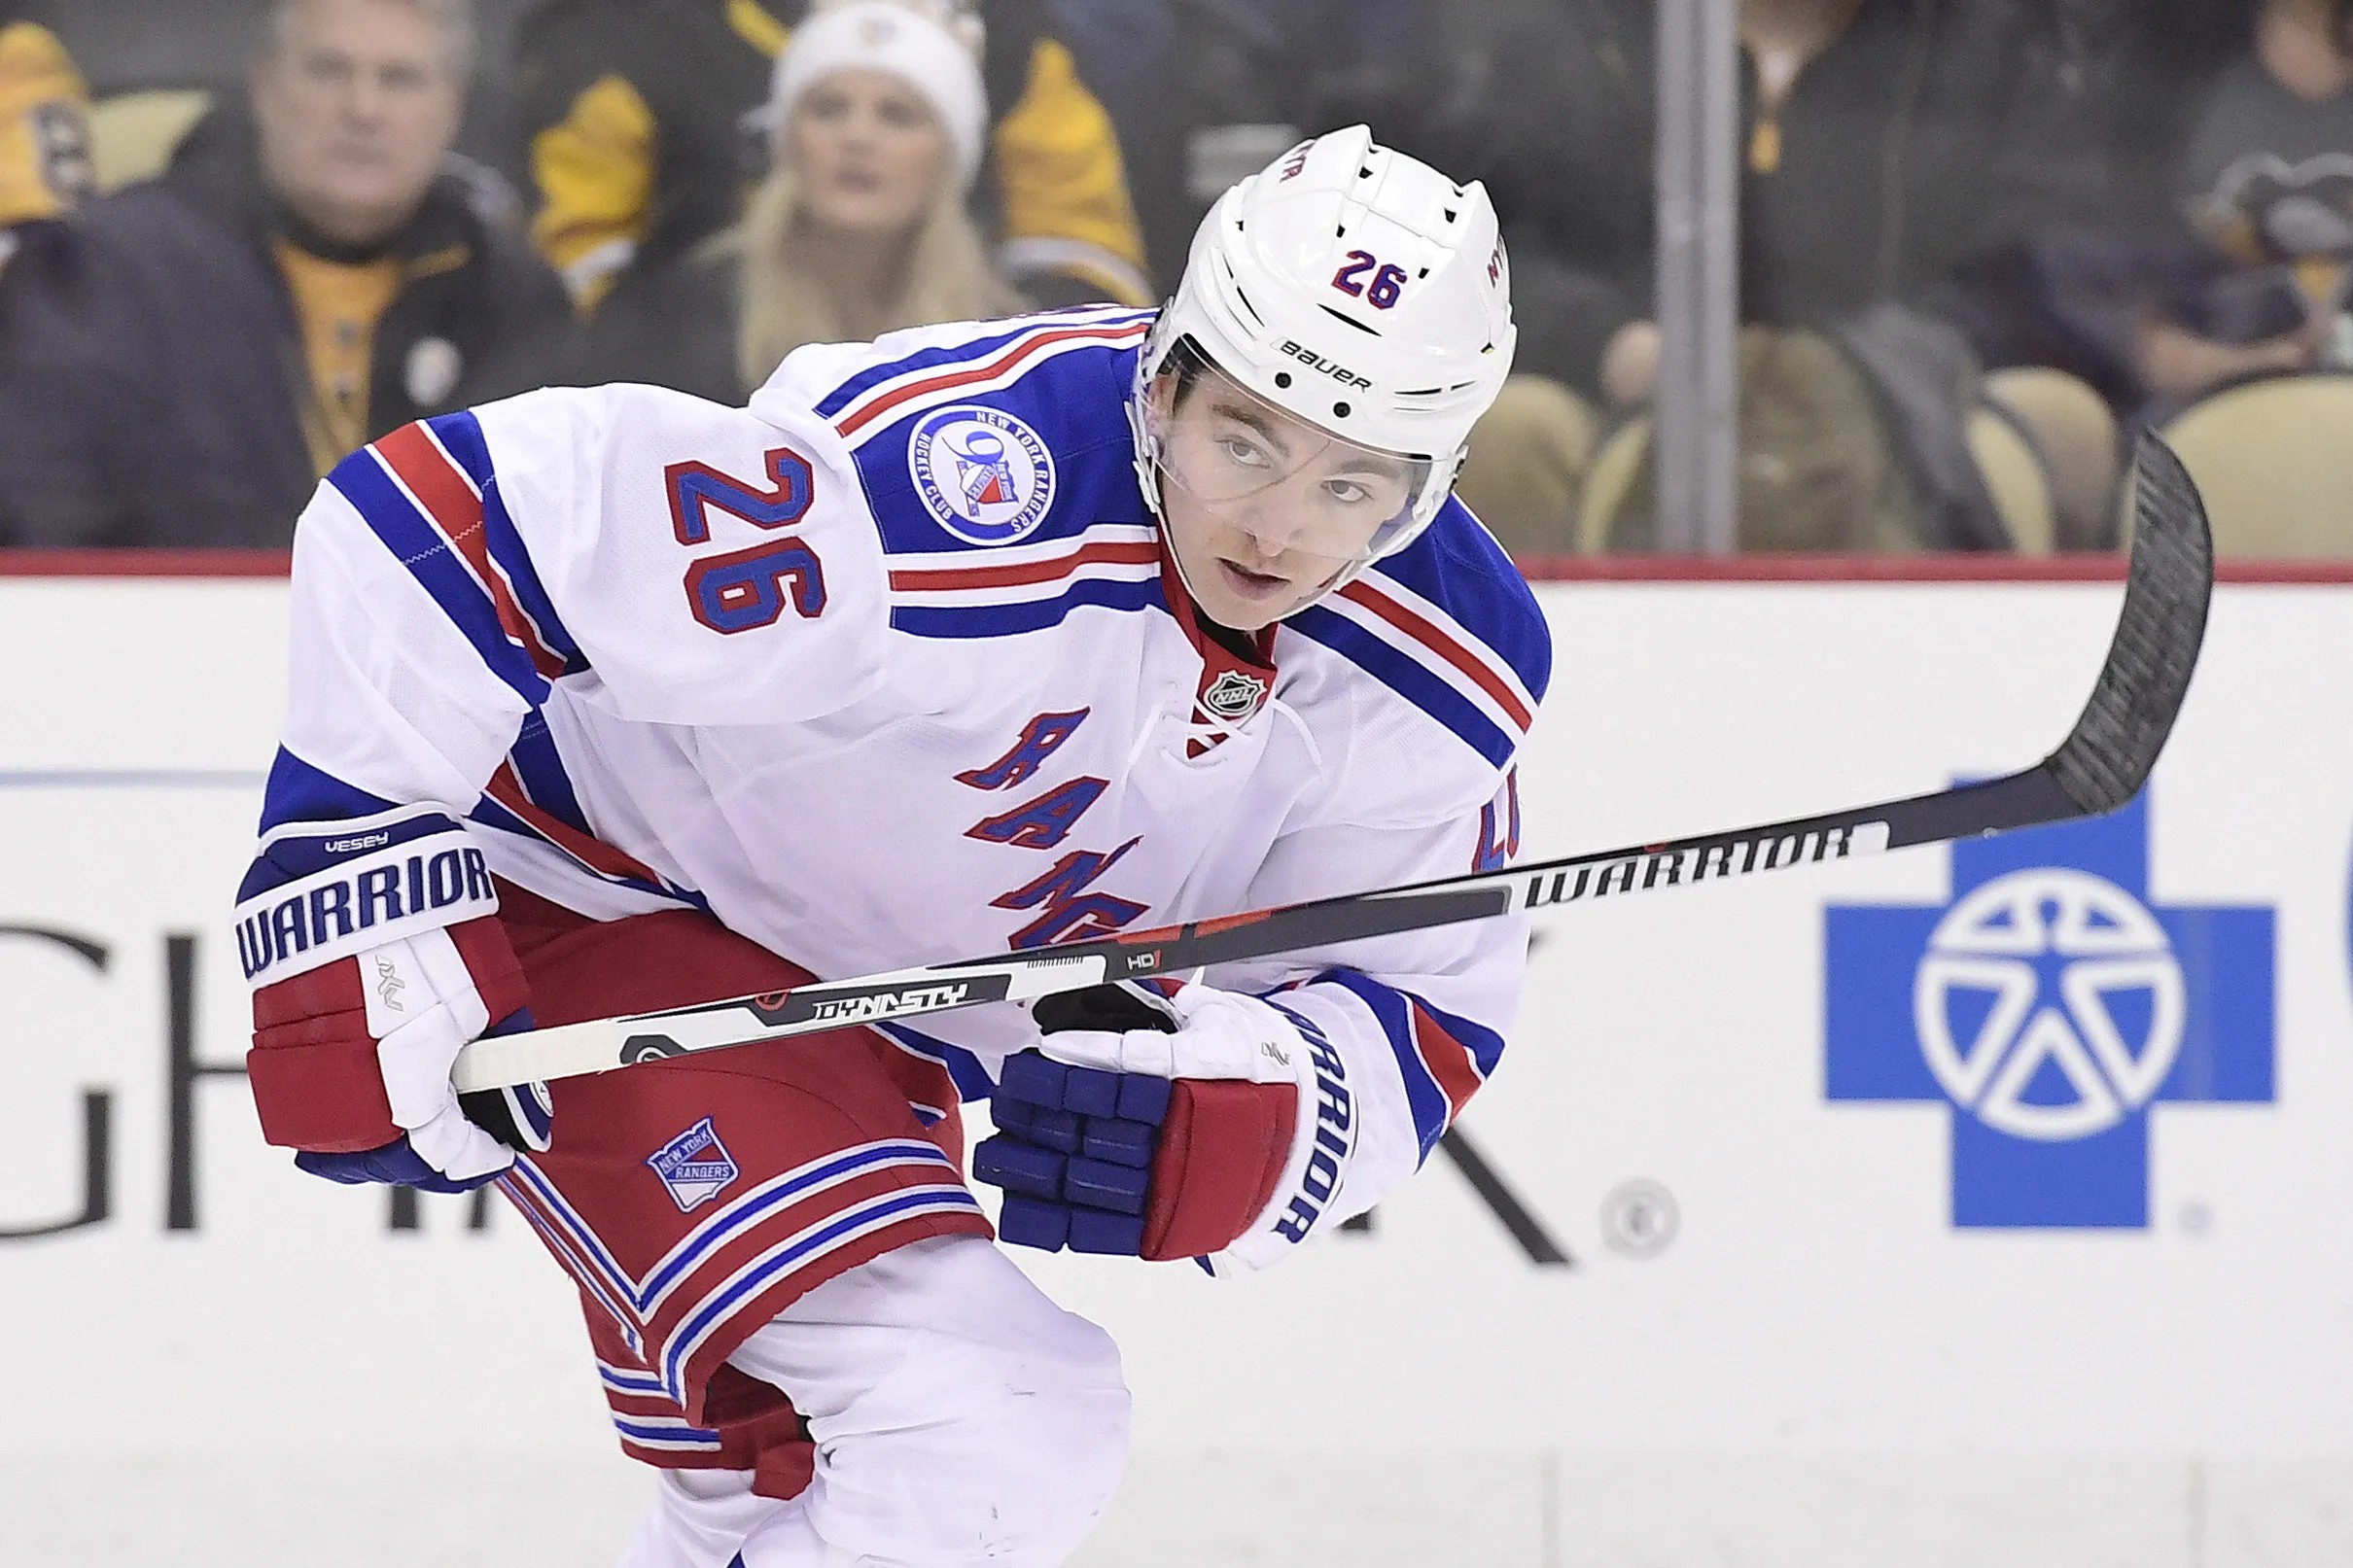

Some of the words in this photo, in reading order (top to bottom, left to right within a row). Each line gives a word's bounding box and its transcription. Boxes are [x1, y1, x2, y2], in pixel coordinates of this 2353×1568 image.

[1330, 250, 1408, 310] 26
[1280, 340, 1372, 393] BAUER
[976, 411, 1009, 430] NEW
[1014, 427, 1044, 465] YORK
[915, 433, 931, 480] HOCKEY
[926, 485, 953, 520] CLUB
[1011, 470, 1049, 534] RANGERS
[664, 447, 827, 635] 26
[1213, 686, 1251, 703] NHL
[325, 831, 389, 853] VESEY
[1524, 826, 1850, 909] WARRIOR
[235, 848, 493, 980] WARRIOR
[813, 983, 969, 1020] DYNASTY
[658, 1148, 682, 1171] NEW
[681, 1129, 712, 1154] YORK
[675, 1166, 730, 1179] RANGERS
